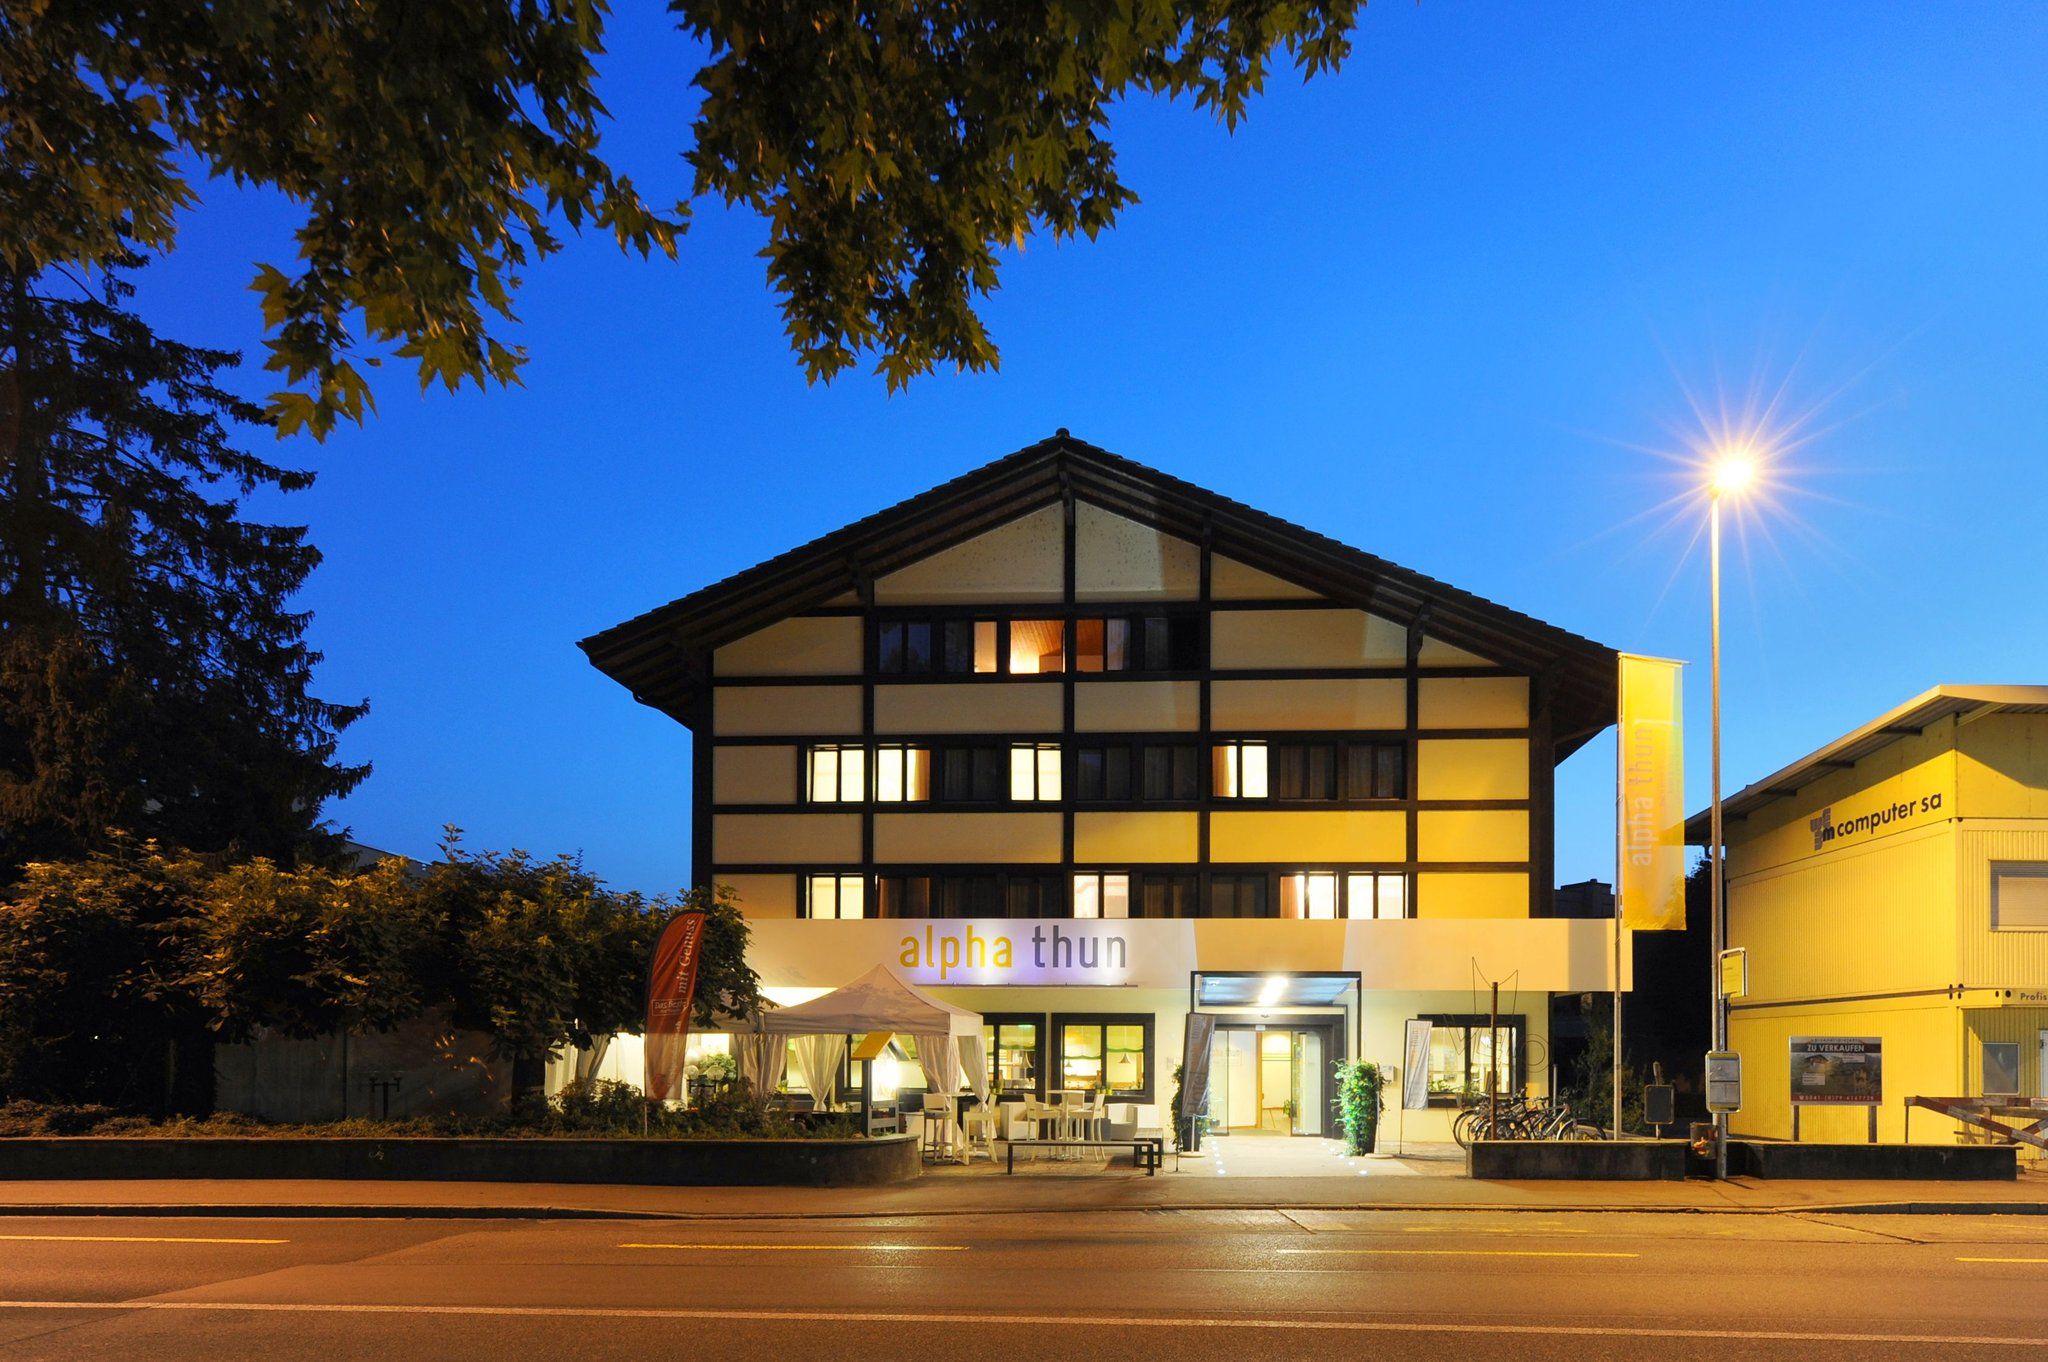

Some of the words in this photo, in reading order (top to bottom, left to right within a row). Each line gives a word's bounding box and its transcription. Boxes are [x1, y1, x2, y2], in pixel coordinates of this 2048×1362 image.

[1629, 728, 1653, 785] thun
[1628, 797, 1659, 866] alpha
[1837, 800, 1917, 837] computer
[1921, 793, 1942, 813] sa
[679, 918, 696, 967] Genuss
[900, 925, 1013, 980] alpha
[1032, 925, 1126, 969] thun
[676, 970, 690, 993] mit
[1807, 1044, 1817, 1052] ZU
[1819, 1044, 1865, 1052] VERKAUFEN
